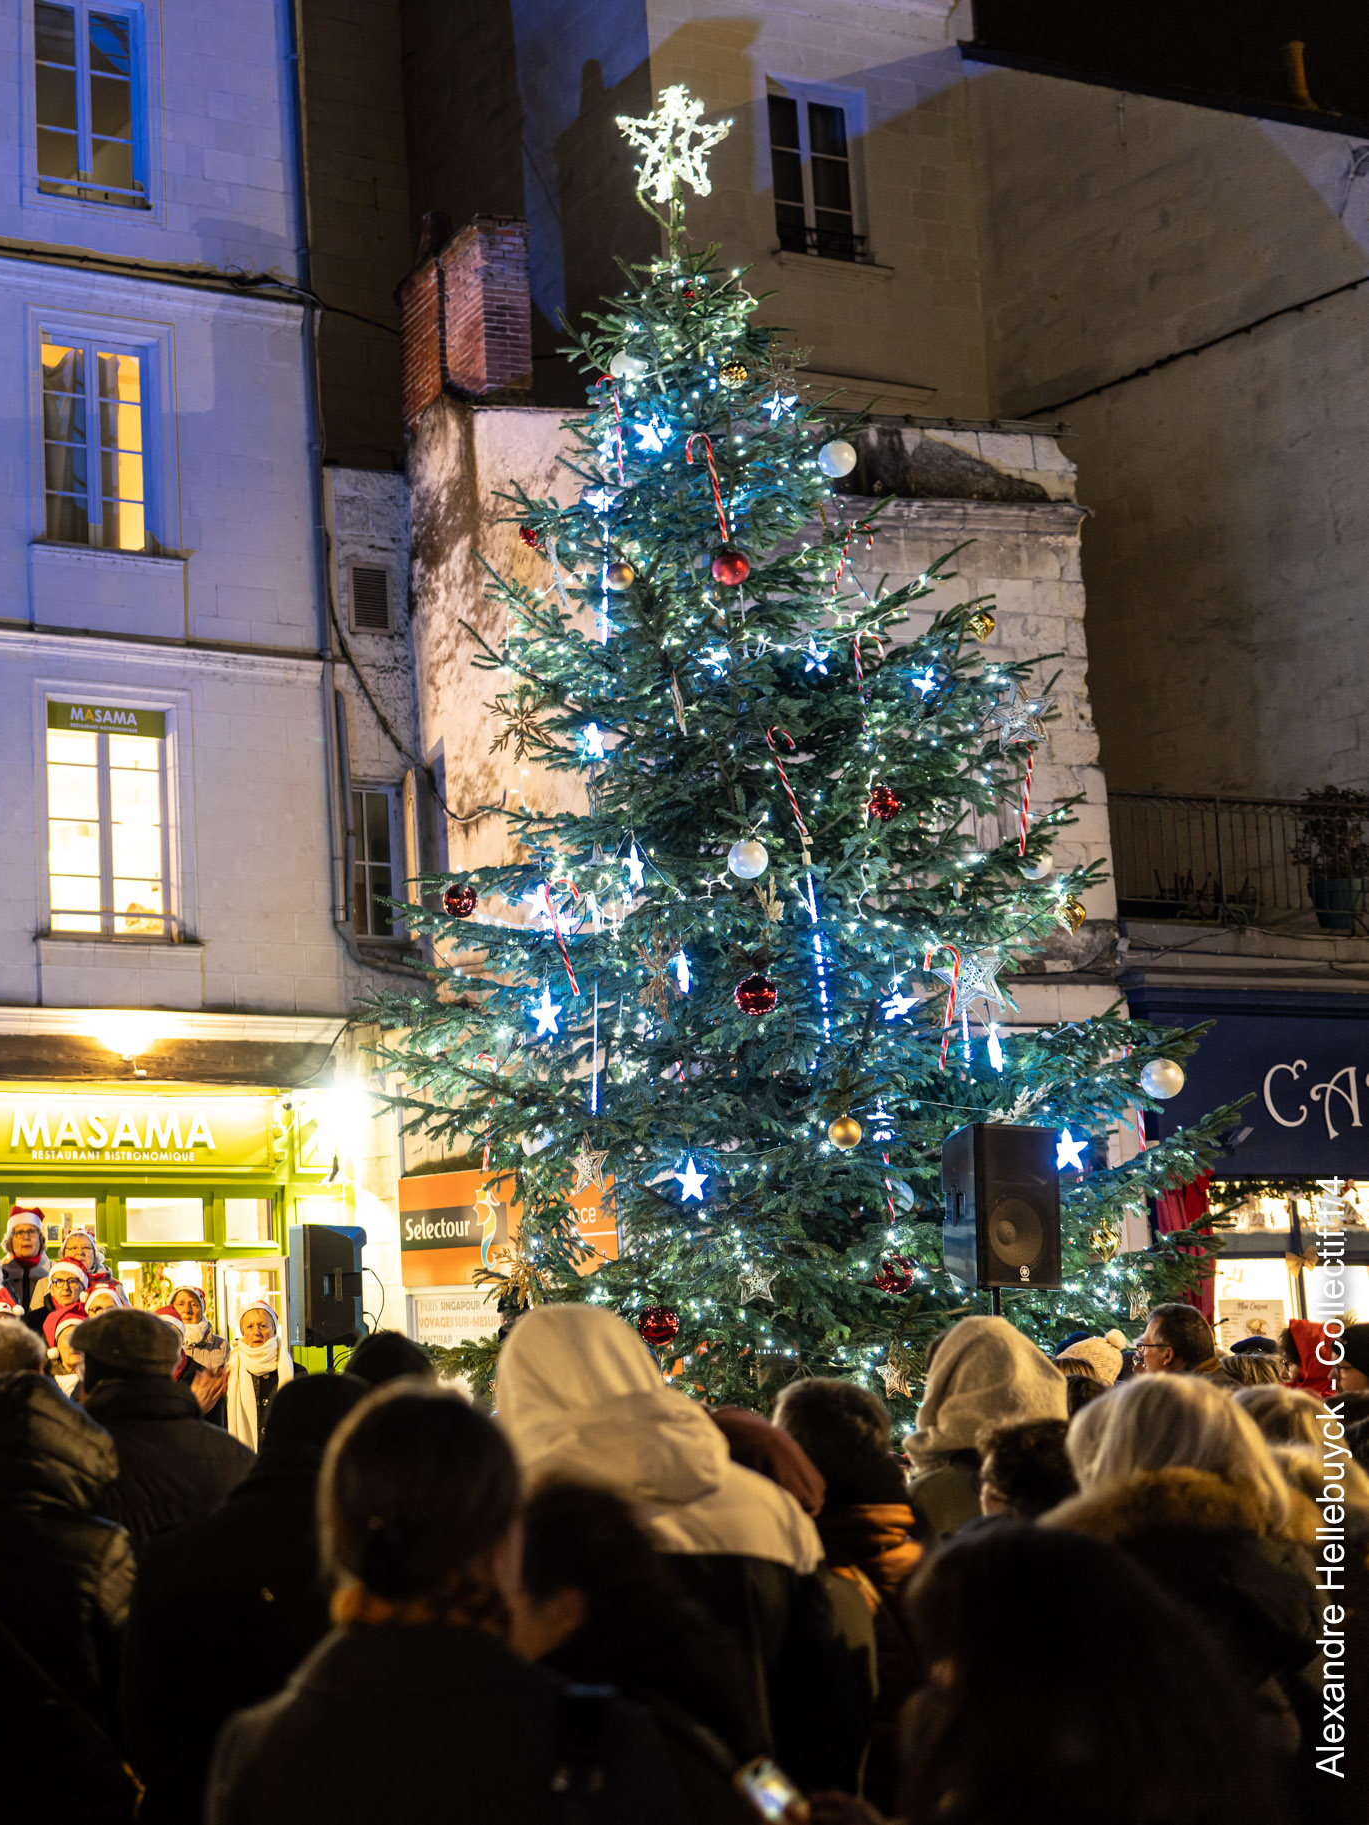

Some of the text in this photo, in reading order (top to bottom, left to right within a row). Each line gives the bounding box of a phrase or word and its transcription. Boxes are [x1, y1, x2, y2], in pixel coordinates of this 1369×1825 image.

[70, 707, 137, 726] MASAMA
[1264, 1059, 1369, 1140] CA
[10, 1107, 216, 1150] MASAMA
[31, 1149, 195, 1162] RESTAURANT BISTRONOMIQUE
[405, 1216, 471, 1241] Selectour
[440, 1300, 481, 1311] SINGAPOUR
[418, 1315, 499, 1329] VOYAGES SUR-MESUR
